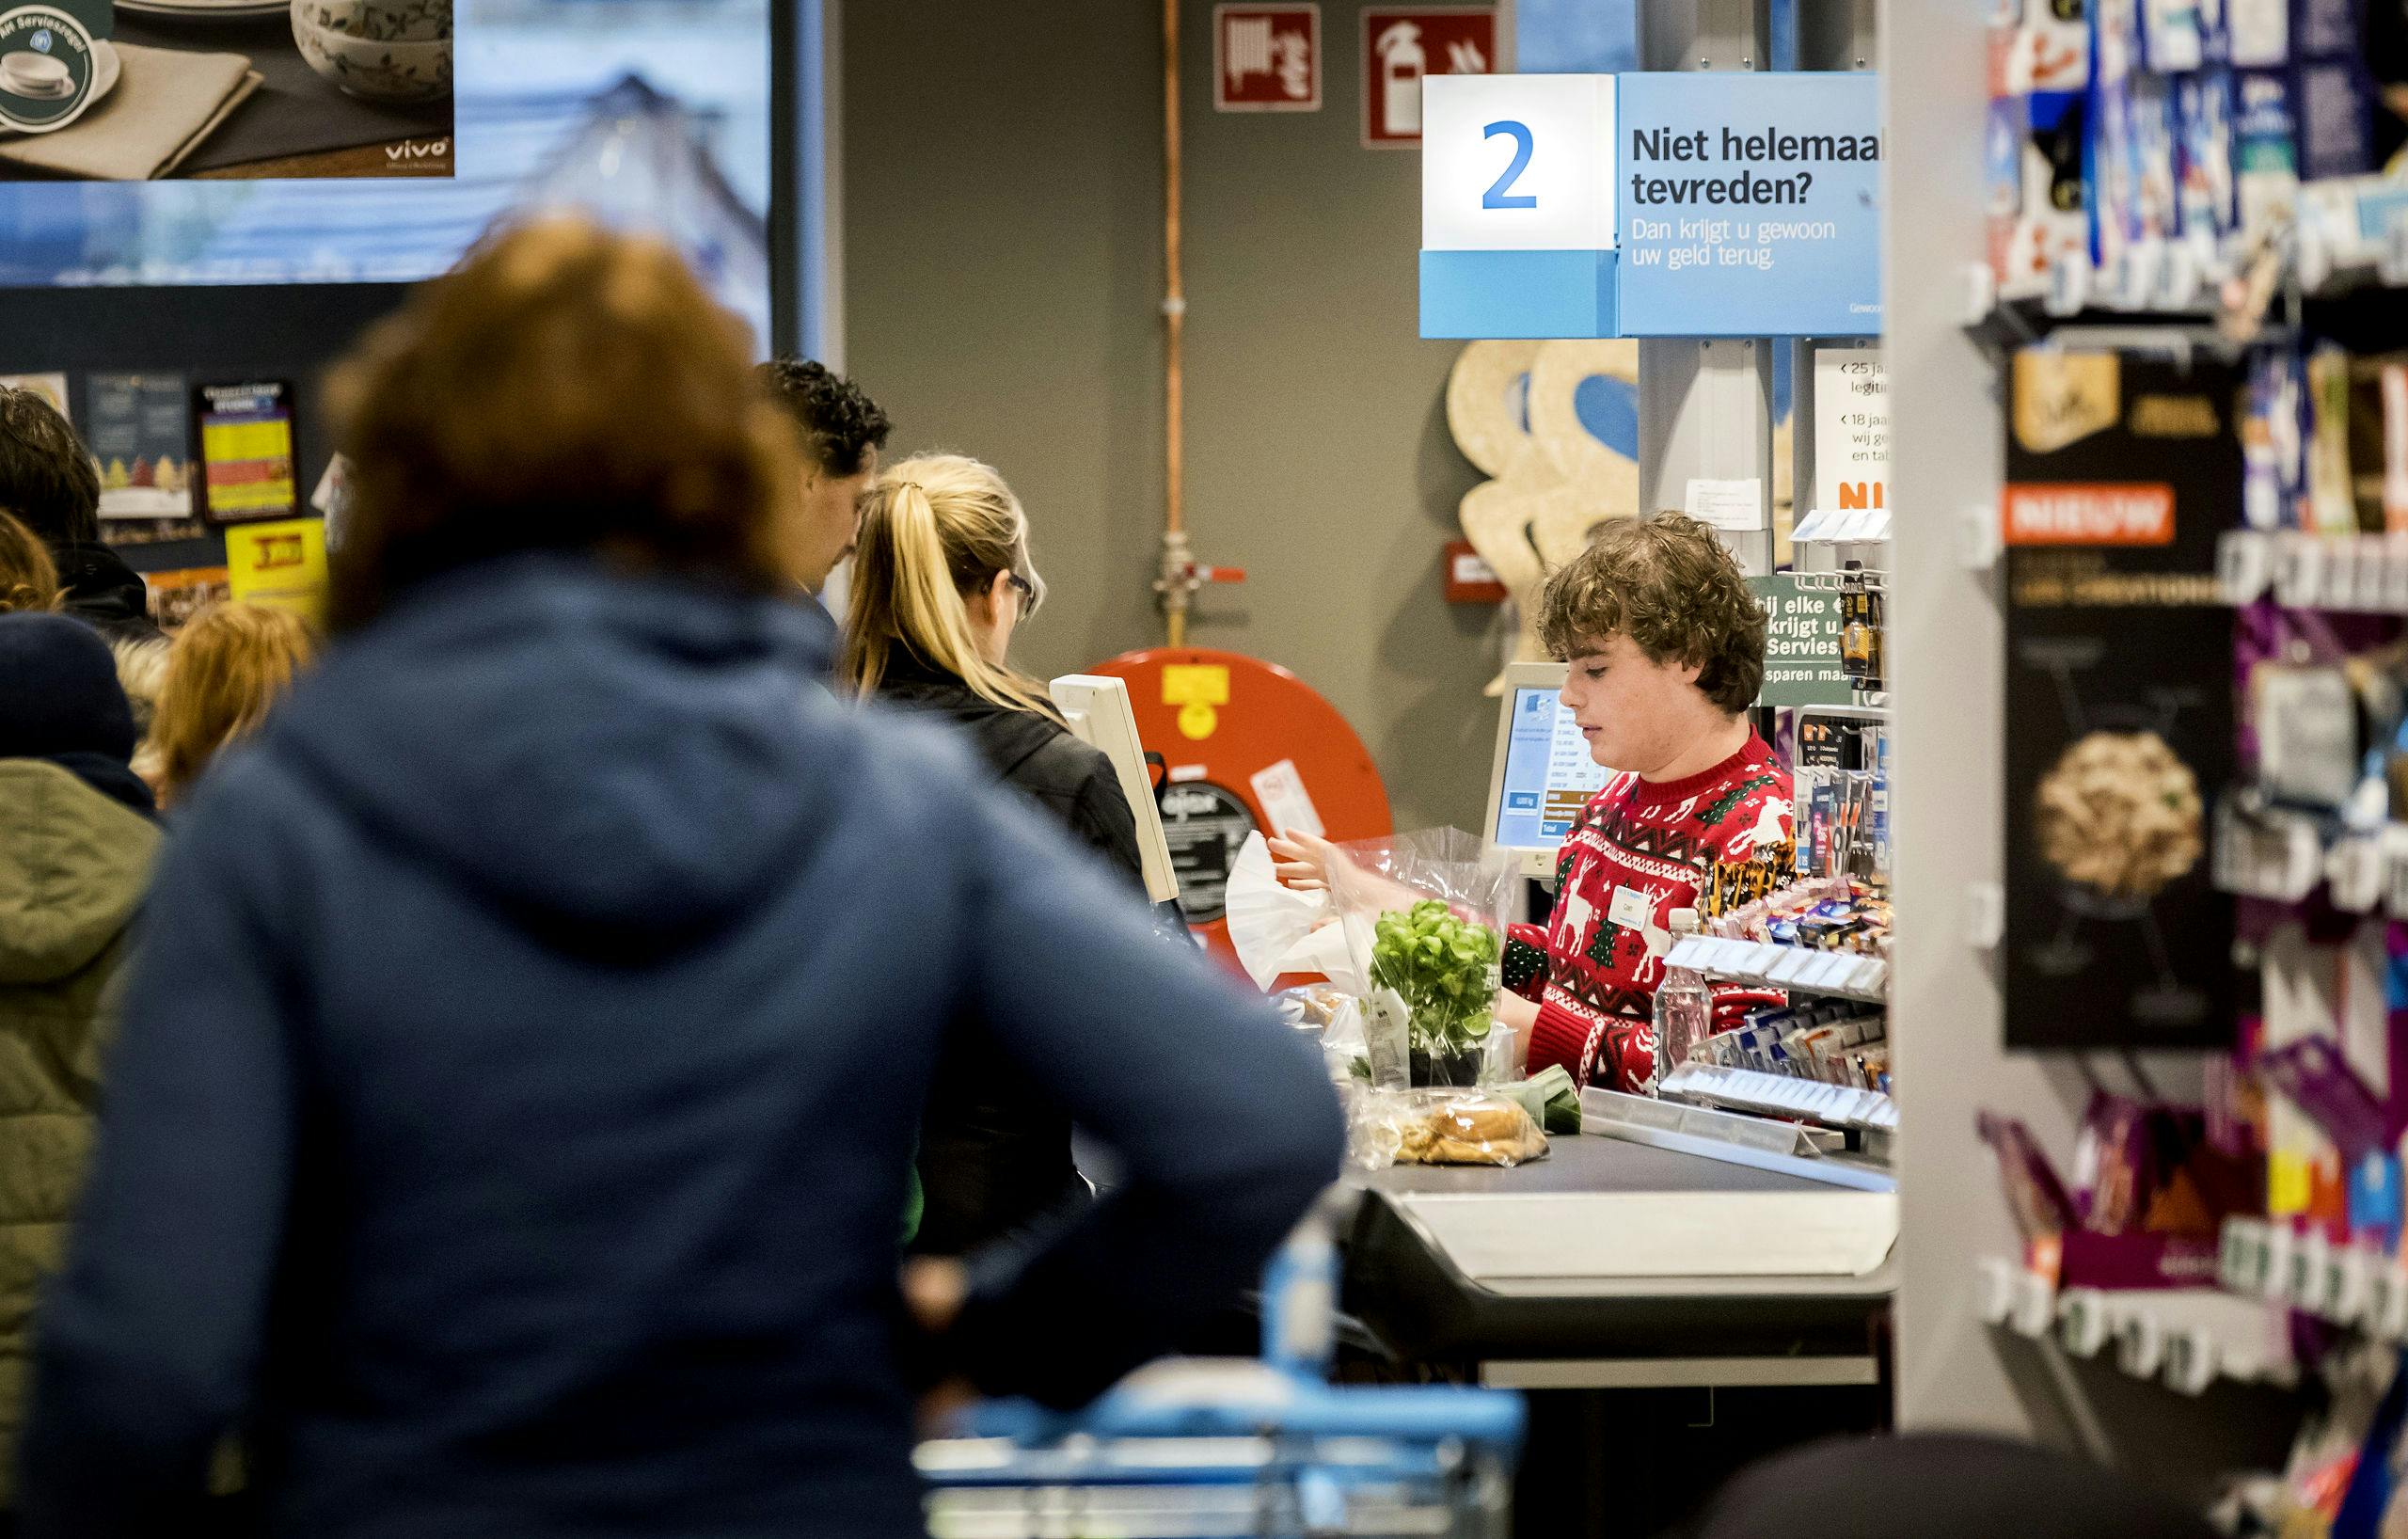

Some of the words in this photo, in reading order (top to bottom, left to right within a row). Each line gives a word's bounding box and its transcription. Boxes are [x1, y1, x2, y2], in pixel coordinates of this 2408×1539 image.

[386, 139, 447, 160] vivo
[1632, 127, 1708, 162] Niet
[1482, 120, 1537, 210] 2
[1631, 170, 1813, 204] tevreden?
[1632, 218, 1671, 240] Dan
[1680, 217, 1730, 243] krijgt
[1737, 225, 1751, 240] u
[1757, 223, 1836, 243] gewoon
[1632, 250, 1661, 265] uw
[1668, 245, 1710, 270] geld
[1718, 246, 1775, 270] terug.
[1851, 362, 1869, 374] 25
[1852, 414, 1865, 425] 18
[1868, 414, 1891, 429] jaa
[1852, 433, 1870, 446] wij
[1852, 452, 1869, 461] en
[1840, 482, 1883, 509] NI
[2010, 492, 2170, 540] NIEUW
[1784, 595, 1825, 613] elke
[1768, 616, 1819, 638] krijgt
[1826, 620, 1837, 634] u
[1766, 638, 1841, 655] Servies
[1766, 669, 1814, 684] sparen
